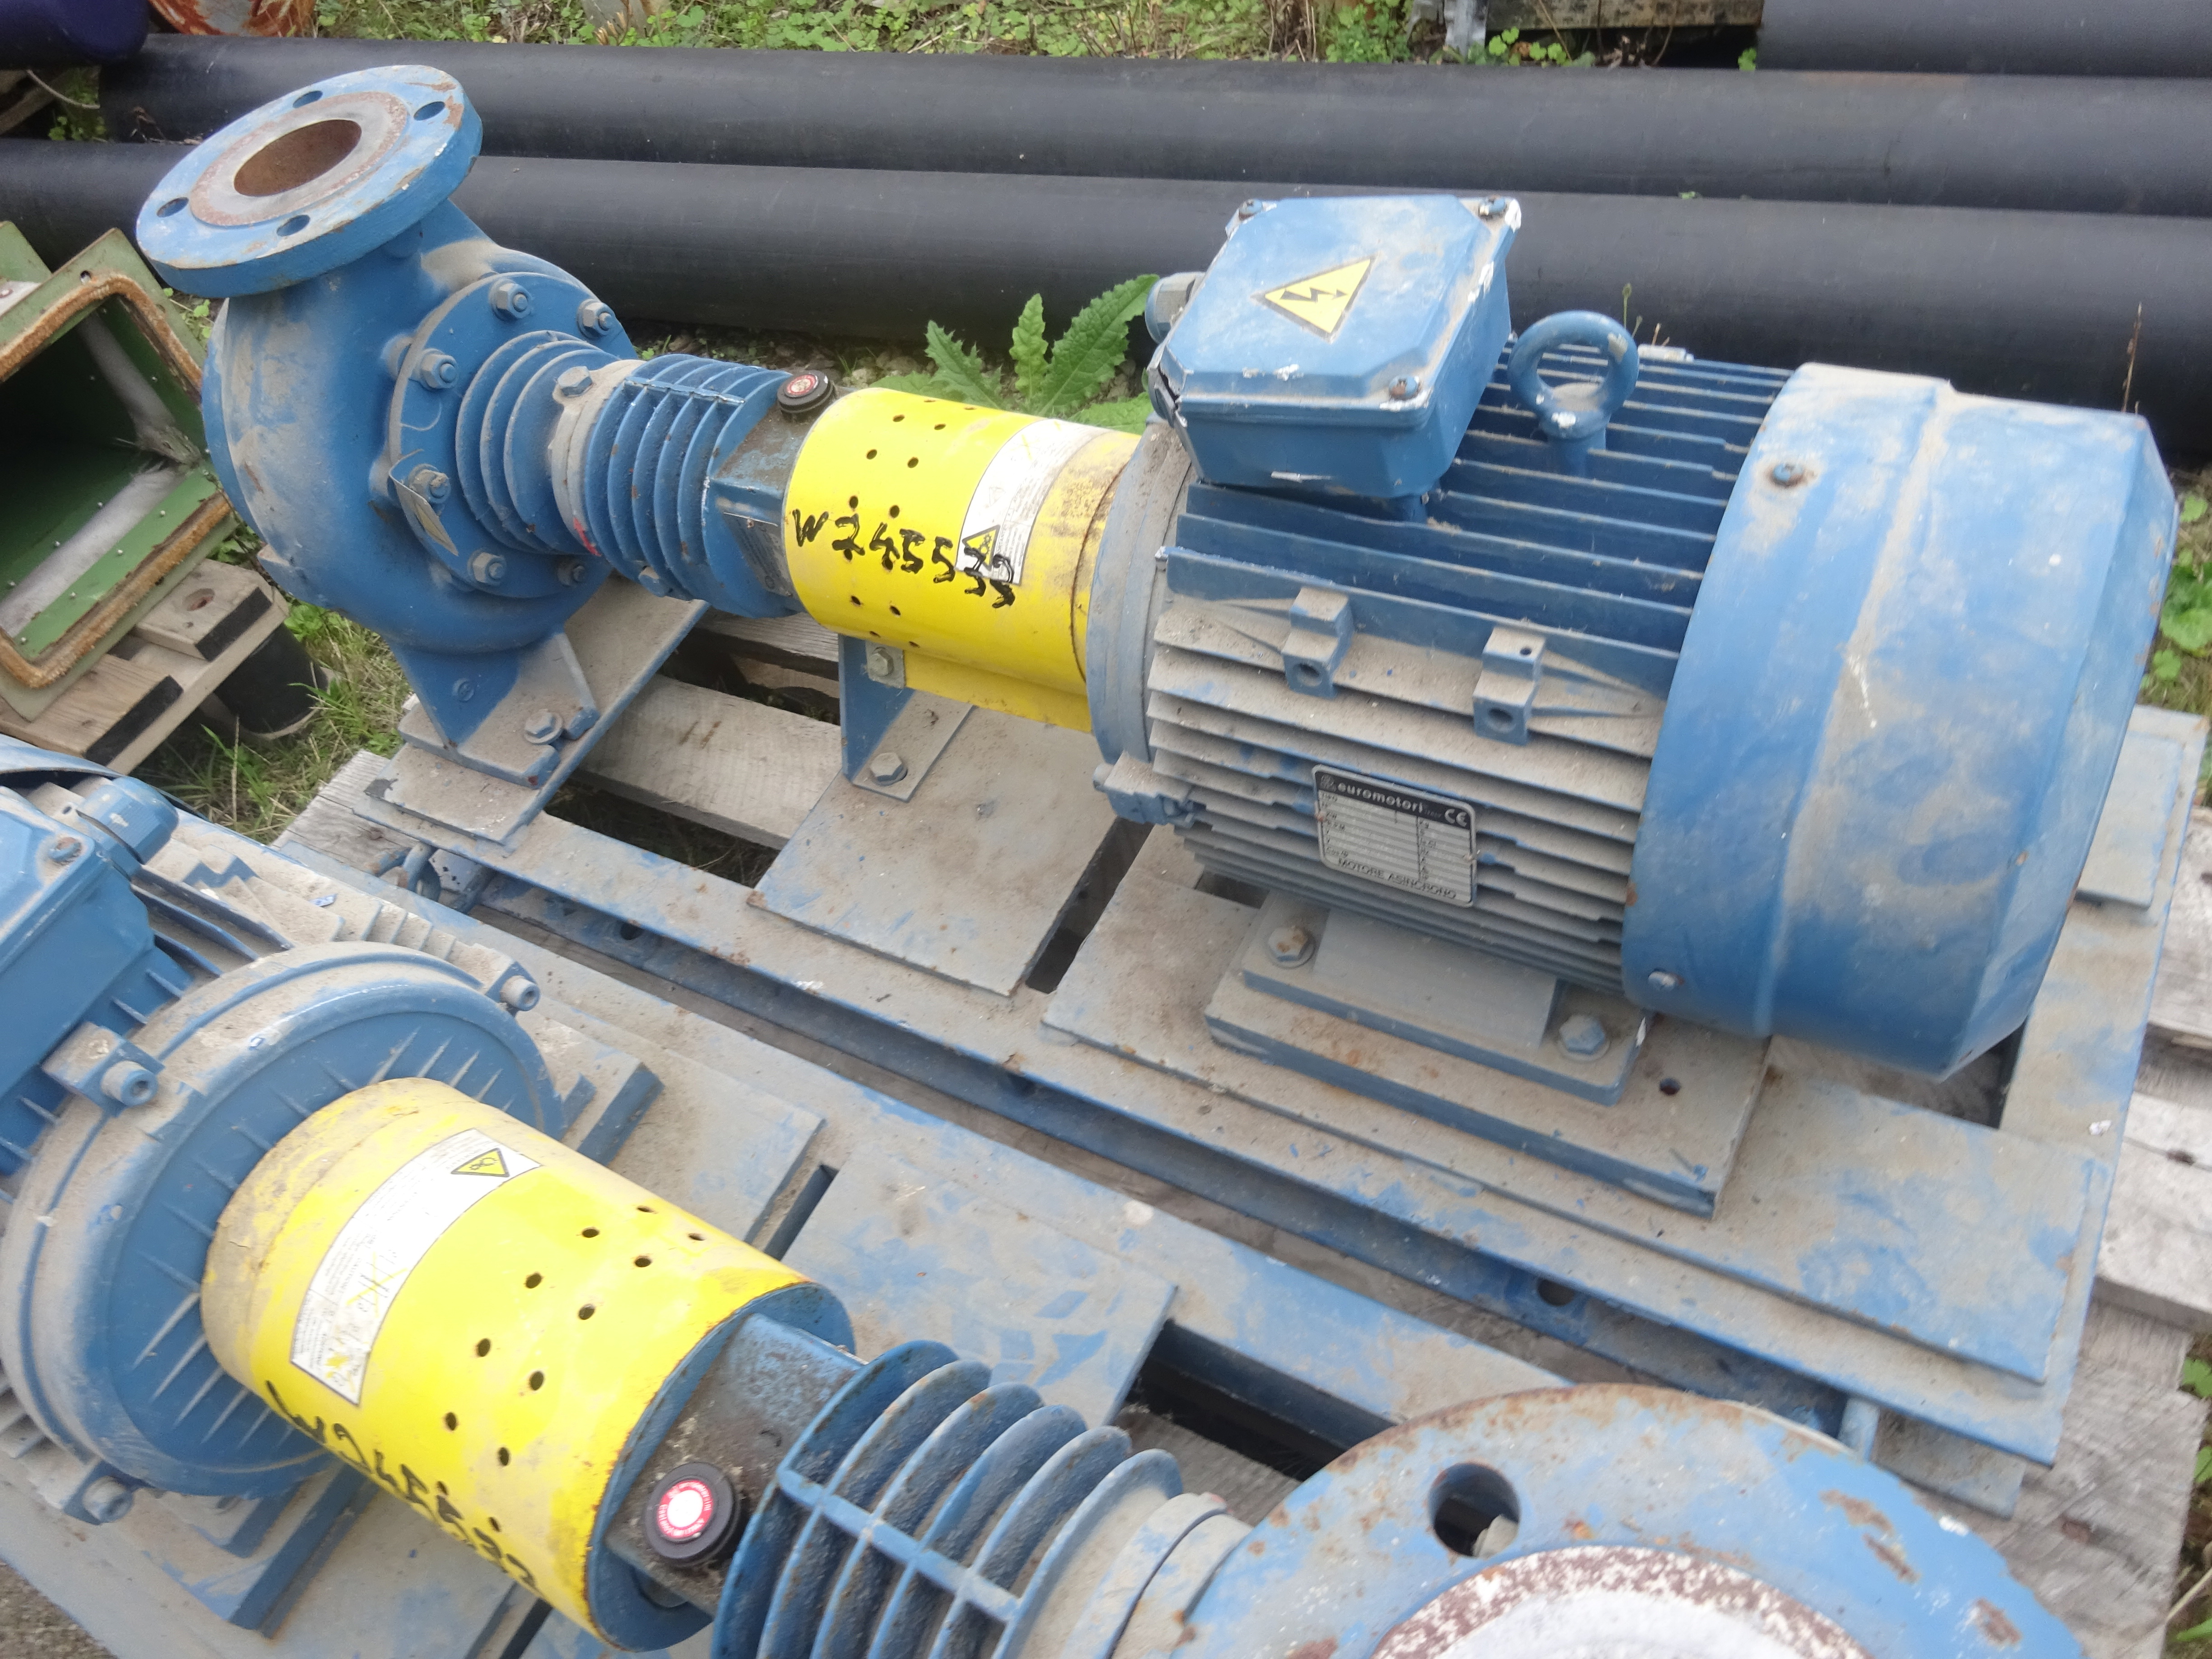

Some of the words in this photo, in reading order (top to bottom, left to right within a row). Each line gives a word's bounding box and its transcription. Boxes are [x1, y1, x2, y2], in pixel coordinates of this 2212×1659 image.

[1337, 782, 1423, 813] euromotori
[1338, 857, 1385, 880] MOTORE
[1387, 872, 1457, 900] ASINCRONO
